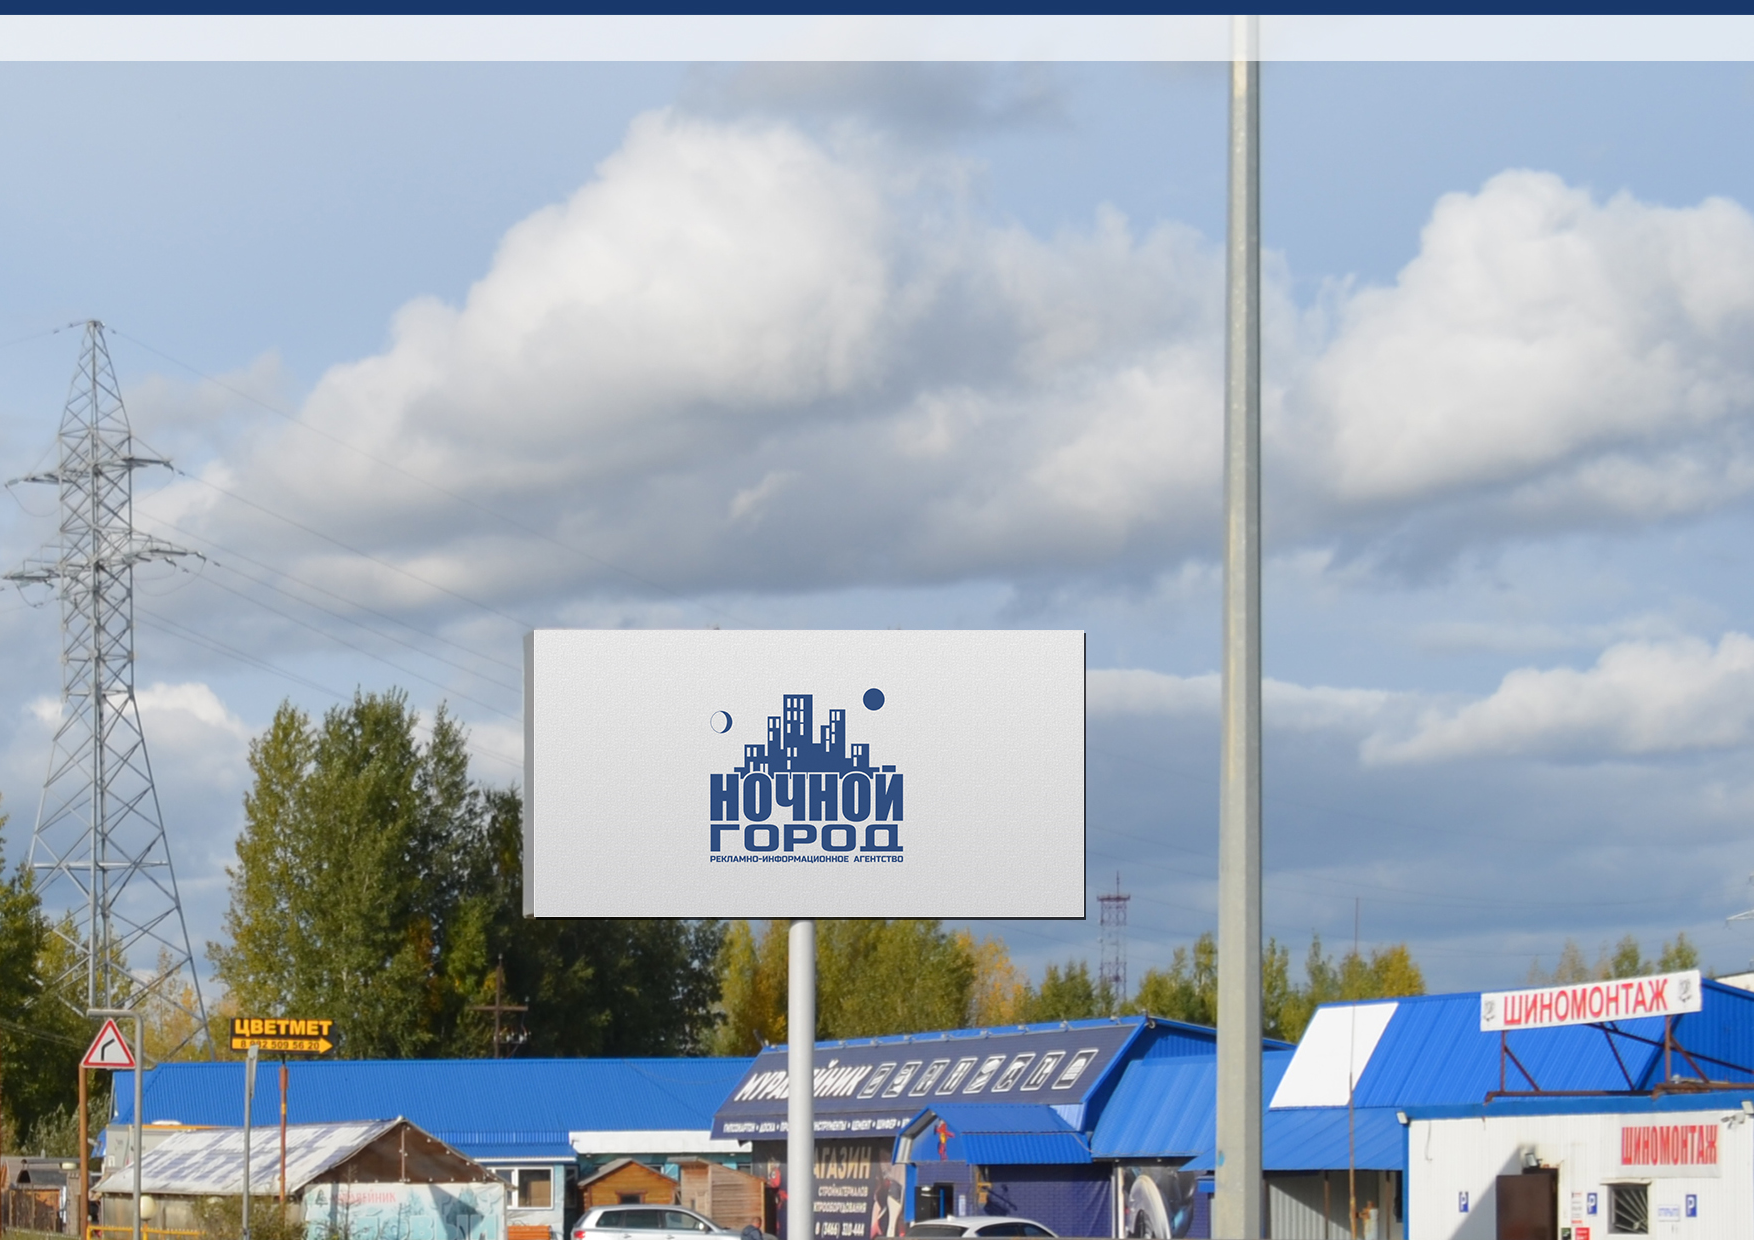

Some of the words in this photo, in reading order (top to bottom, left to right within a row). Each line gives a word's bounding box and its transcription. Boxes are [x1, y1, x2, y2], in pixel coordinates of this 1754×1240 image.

[709, 765, 904, 822] НОЧНОЙ
[709, 823, 904, 852] ГОРОД
[709, 855, 850, 864] РЕКЛАМНО-ИНФОРМАЦИОННОЕ
[853, 855, 904, 863] АГЕНТСТВО
[1503, 978, 1668, 1026] ШИНОМОНТАЖ
[235, 1018, 333, 1037] ЦВЕТМЕТ
[1621, 1124, 1719, 1166] ШИНОМОНТАЖ
[813, 1147, 872, 1179] АГАЗИН
